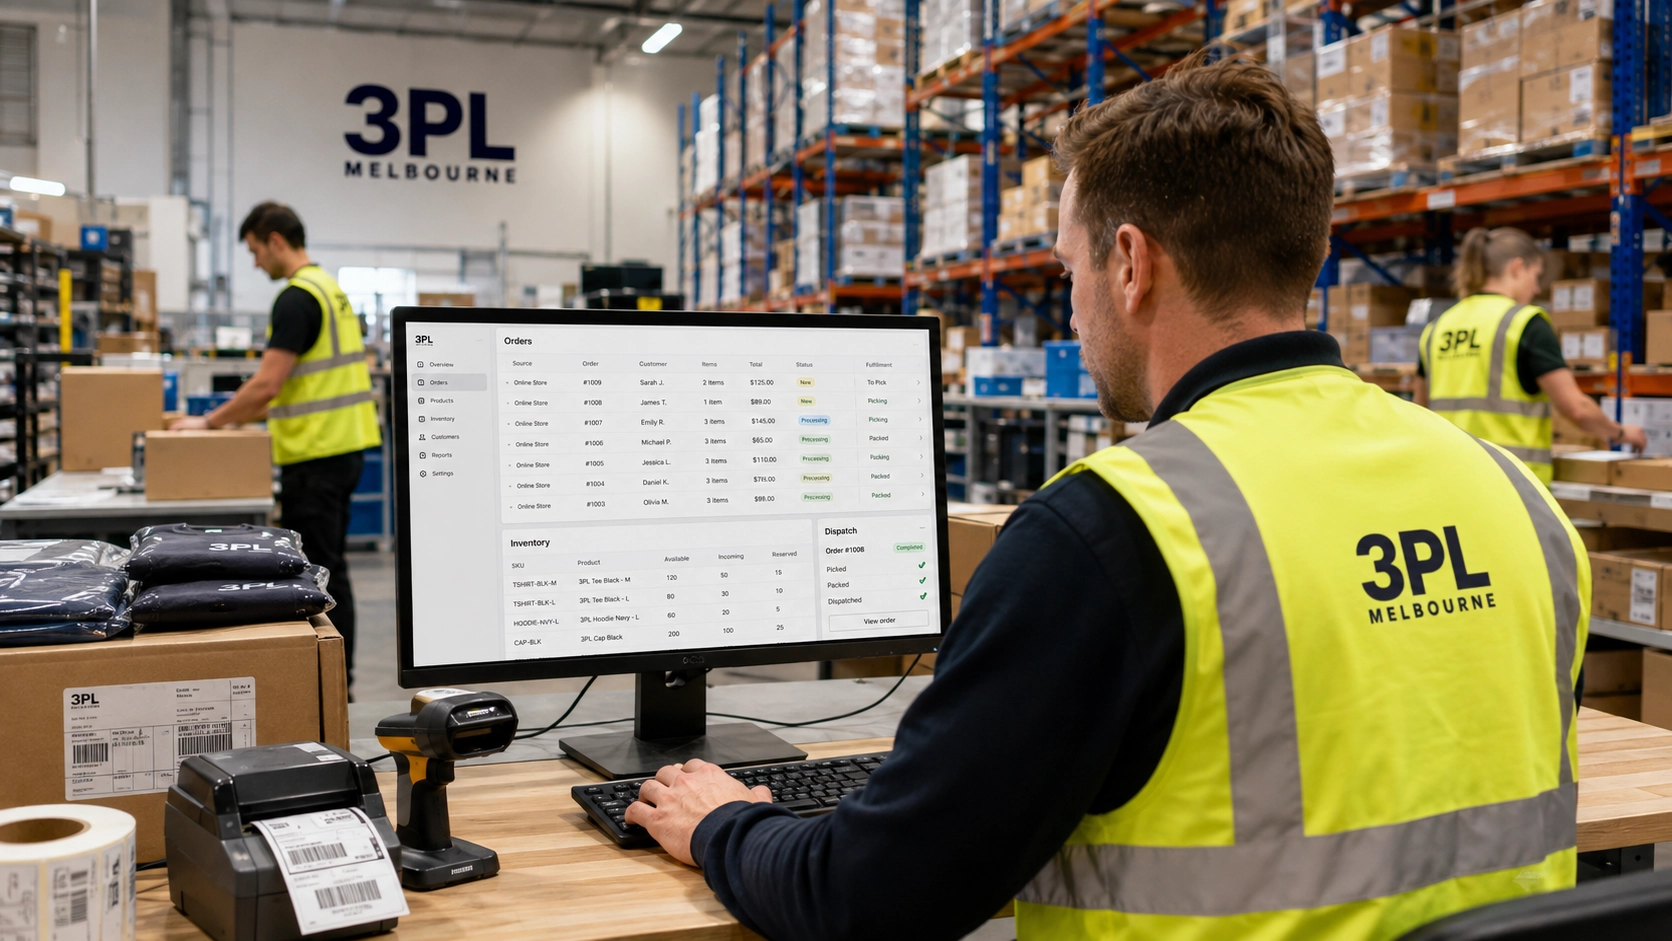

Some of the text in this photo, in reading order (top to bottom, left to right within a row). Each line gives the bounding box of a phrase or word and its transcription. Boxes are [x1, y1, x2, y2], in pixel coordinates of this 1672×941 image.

[344, 84, 515, 161] 3PL
[344, 161, 516, 183] MELBOURNE
[415, 335, 433, 343] 3PL
[504, 336, 532, 345] Orders
[1440, 329, 1481, 352] 3PL
[640, 378, 658, 386] Sarah
[750, 378, 774, 386] $125.00
[514, 399, 548, 407] Online Store
[662, 398, 667, 406] T.
[704, 398, 707, 406] 1
[751, 398, 771, 406] $89.00
[868, 397, 887, 405] Picking
[431, 415, 455, 423] Inventory
[585, 419, 602, 427] #1007
[641, 418, 665, 426] Emily R.
[752, 417, 775, 425] $145.00
[801, 417, 828, 425] Processing
[869, 416, 888, 424] Picking
[431, 433, 459, 441] Customers
[704, 437, 709, 445] 3
[752, 436, 773, 444] $65.00
[535, 440, 549, 448] Store
[585, 439, 603, 447] #1006
[641, 438, 671, 446] Michael P.
[432, 451, 452, 459] Reports
[586, 459, 604, 467] #1005
[642, 458, 671, 467] Jessica L.
[705, 457, 710, 465] 3
[753, 456, 777, 464] $110.00
[516, 461, 550, 469] Online Store
[432, 470, 453, 478] Settings
[586, 480, 604, 488] #1004
[643, 478, 669, 486] Daniel K.
[706, 477, 711, 485] 3
[517, 482, 534, 490] Online
[537, 502, 551, 510] Store
[587, 500, 605, 508] #1003
[643, 498, 660, 506] Olivia
[825, 526, 857, 536] Dispatch
[209, 542, 272, 552] 3PL
[511, 539, 550, 548] Inventory
[772, 550, 797, 558] Reserved
[825, 545, 865, 555] Order #1008
[664, 555, 689, 563] Available
[718, 553, 744, 561] Incoming
[512, 562, 524, 570] SKU
[1356, 525, 1491, 601] 3PL
[827, 565, 846, 573] Picked
[721, 571, 728, 579] 50
[513, 579, 557, 587] TSHIRT-BLK-M
[603, 576, 620, 584] Black
[827, 581, 849, 589] Packed
[721, 590, 729, 598] 30
[513, 599, 555, 607] TSHIRT-BLK-L
[579, 597, 591, 605] 3PL
[592, 596, 603, 604] Tee
[604, 595, 621, 603] Black
[828, 596, 862, 605] Dispatched
[722, 608, 730, 616] 20
[776, 605, 780, 613] 5
[1369, 593, 1496, 624] MELBOURNE
[667, 611, 675, 619] 60
[881, 617, 896, 625] order
[593, 635, 606, 643] Cap
[607, 633, 623, 641] Black
[668, 630, 680, 638] 200
[514, 638, 541, 646] CAP-BLK
[71, 693, 99, 705] 3PL
